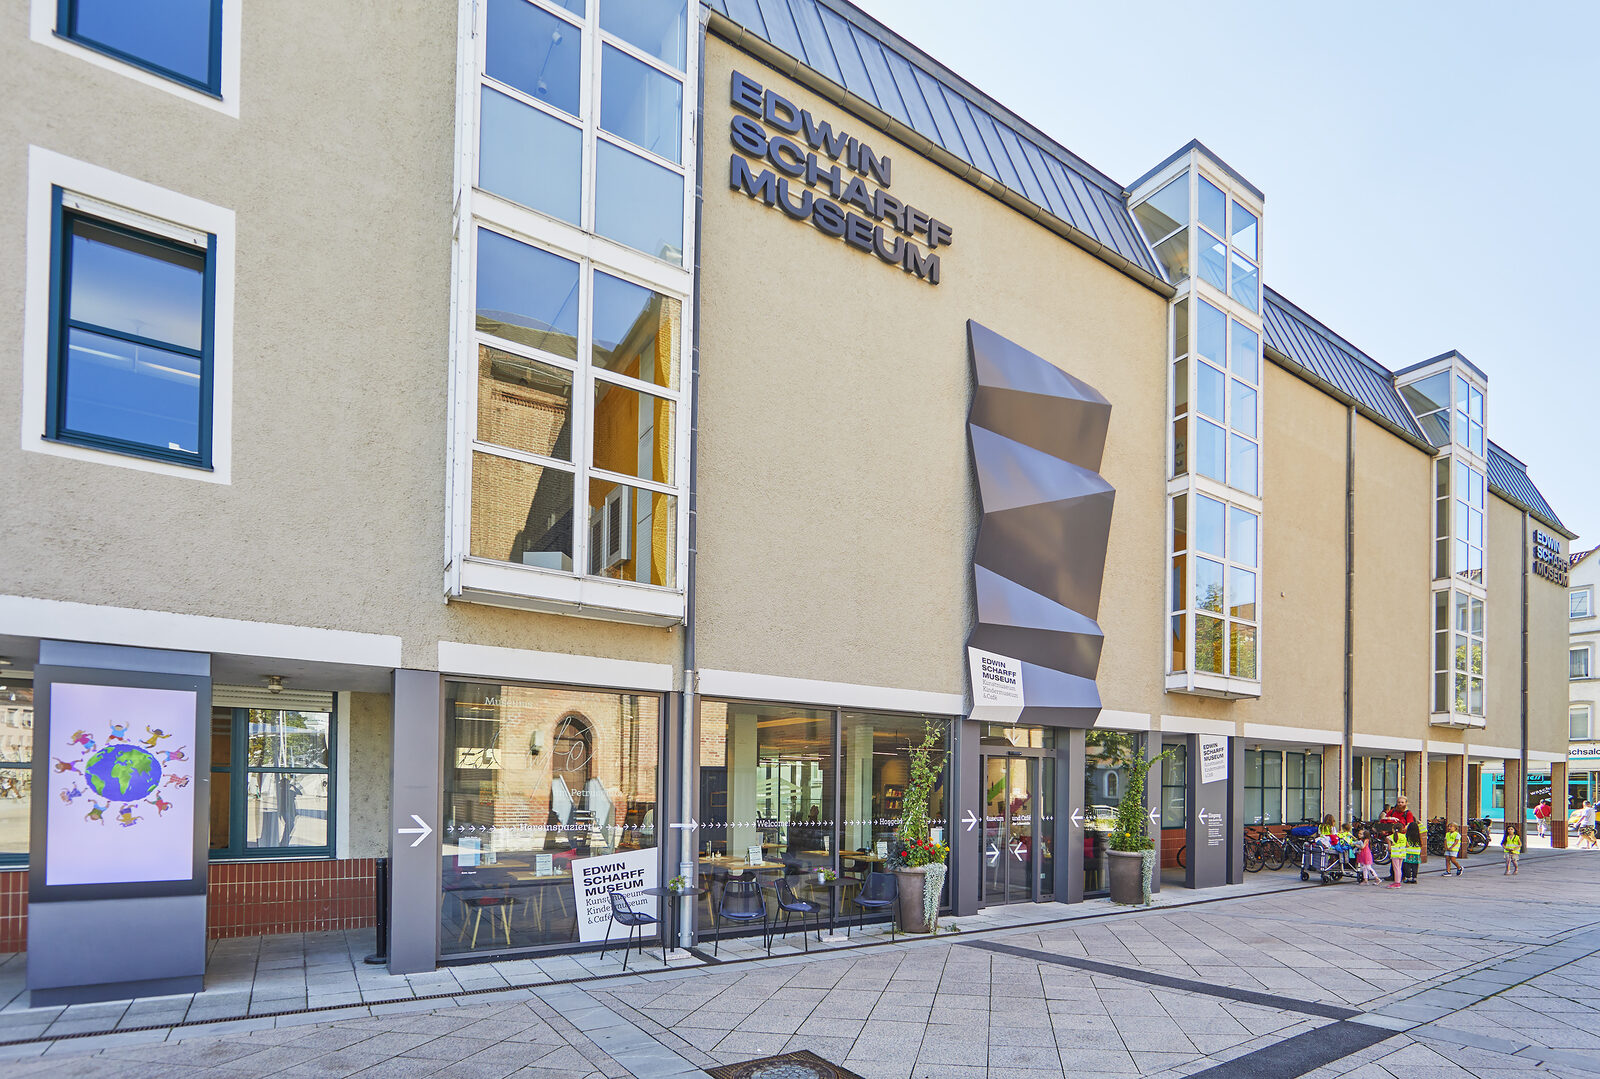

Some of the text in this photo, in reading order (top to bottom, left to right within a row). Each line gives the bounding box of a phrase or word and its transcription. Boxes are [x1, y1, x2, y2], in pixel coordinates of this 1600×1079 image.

[731, 70, 891, 189] EDWIN
[730, 115, 952, 249] SCHARFF
[730, 154, 940, 285] MUSEUM
[1533, 530, 1560, 554] EDWIN
[1533, 561, 1568, 588] MUSEUM
[982, 657, 1006, 668] EDWIN
[982, 664, 1017, 678] SCHARFF
[982, 672, 1017, 685] MUSEUM
[1203, 742, 1218, 750] EDWIN
[1203, 747, 1225, 756] SCHARFF
[1203, 753, 1225, 762] MUSEUM
[756, 819, 791, 828] Welcome!
[583, 862, 626, 877] EDWIN
[583, 868, 645, 887] SCHARFF
[585, 879, 644, 897] MUSEUM
[586, 898, 649, 916] Kindemuseum
